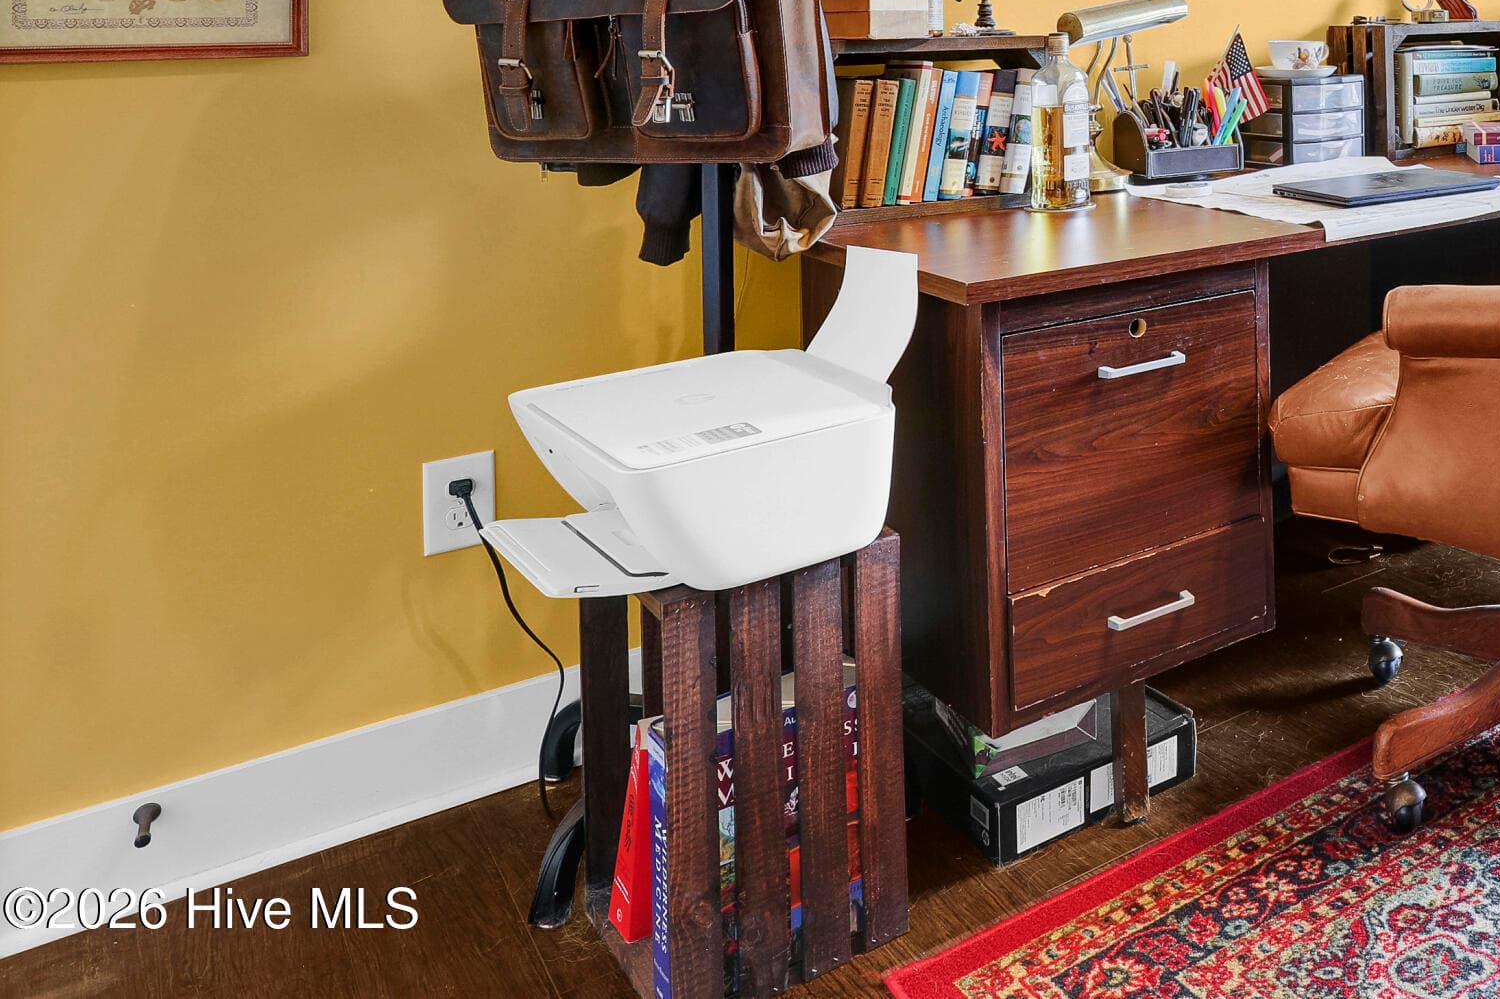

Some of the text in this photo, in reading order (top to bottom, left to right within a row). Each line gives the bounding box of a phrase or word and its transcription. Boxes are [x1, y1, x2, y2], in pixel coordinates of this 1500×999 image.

[935, 105, 950, 147] Archaeology
[1476, 103, 1485, 112] Dig
[653, 816, 663, 943] MEDICINE
[661, 828, 669, 955] WILDERNESS
